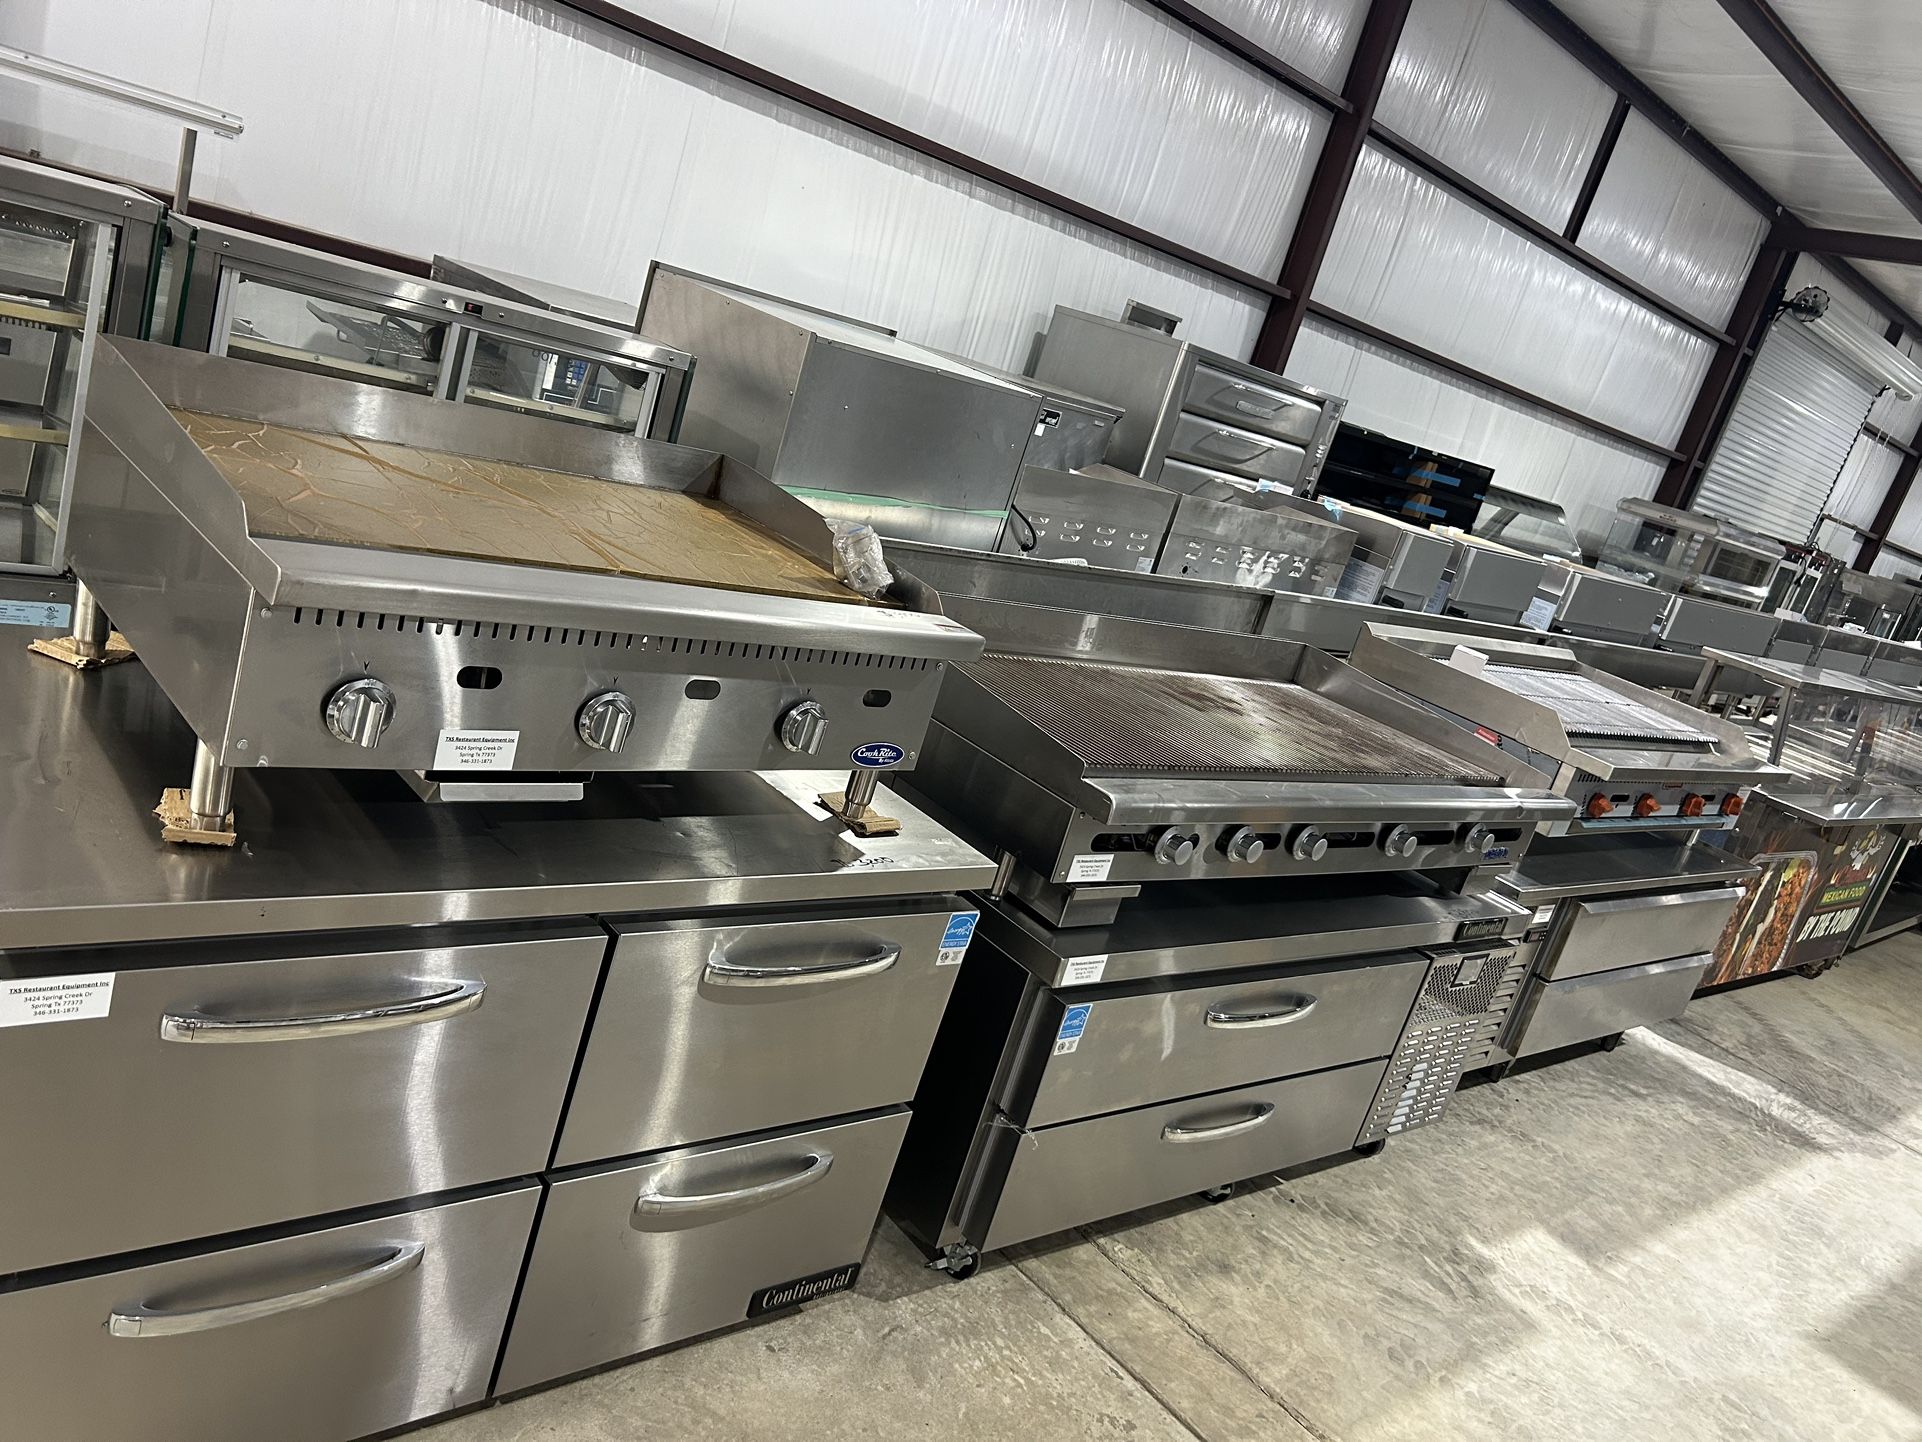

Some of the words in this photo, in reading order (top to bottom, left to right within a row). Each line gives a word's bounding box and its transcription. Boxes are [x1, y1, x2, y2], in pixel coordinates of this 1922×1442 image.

[1850, 886, 1866, 897] FOOD
[1796, 916, 1820, 943] BY
[1810, 912, 1836, 939] THE
[24, 985, 60, 993] Restaurant
[62, 982, 98, 990] Equipment
[33, 1007, 79, 1016] 346-331-1873
[762, 1267, 855, 1308] Continental
